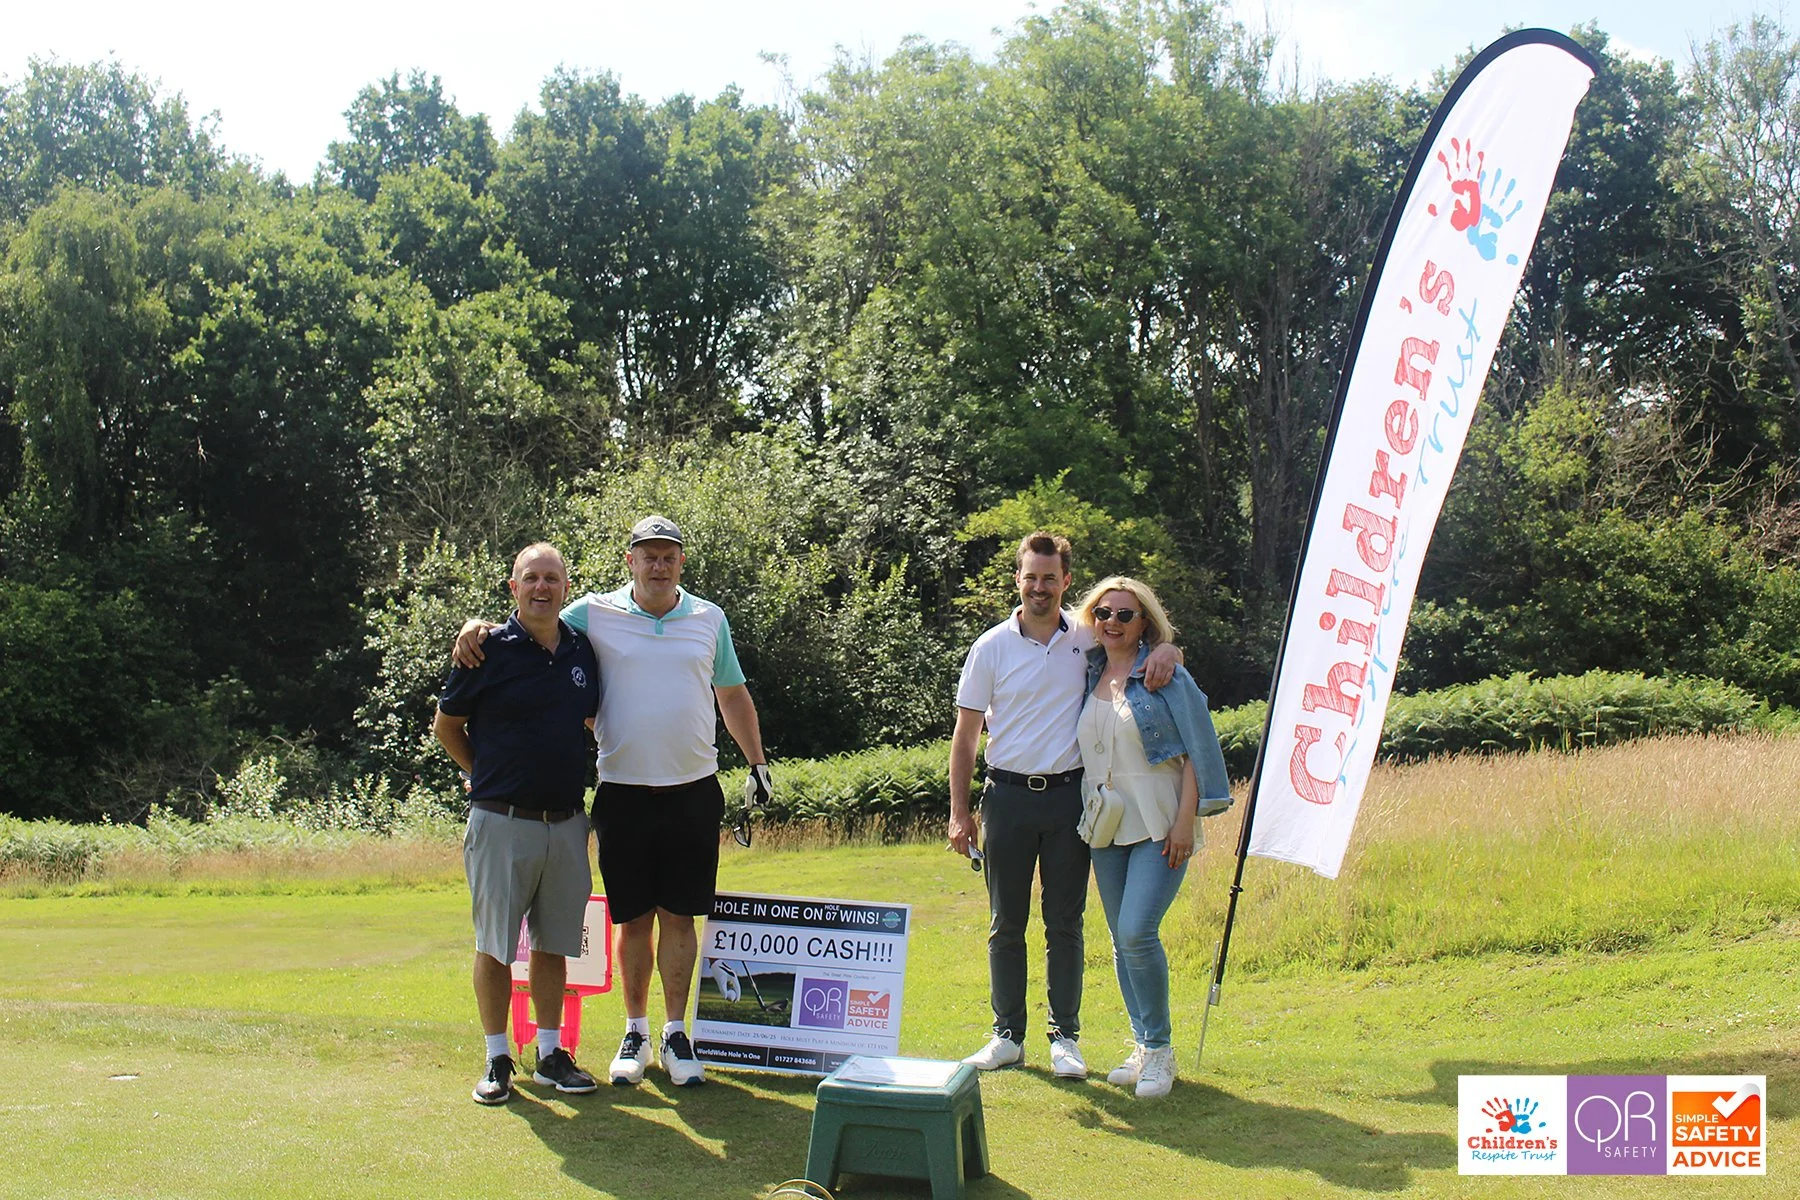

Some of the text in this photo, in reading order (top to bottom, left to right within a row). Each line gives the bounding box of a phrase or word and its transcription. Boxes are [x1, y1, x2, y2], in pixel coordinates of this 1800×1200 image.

[1413, 298, 1481, 492] Trust
[1289, 259, 1455, 805] Children's
[714, 901, 823, 921] HOLE IN ONE ON
[825, 911, 837, 921] 07
[840, 909, 880, 925] WINS!
[714, 930, 893, 963] £10,000 CASH!!!
[804, 987, 842, 1016] QR
[816, 1012, 841, 1021] SAFETY
[848, 1006, 888, 1017] SAFETY
[847, 1019, 889, 1030] ADVICE
[696, 1048, 728, 1057] WorldWide
[774, 1055, 793, 1063] 01727
